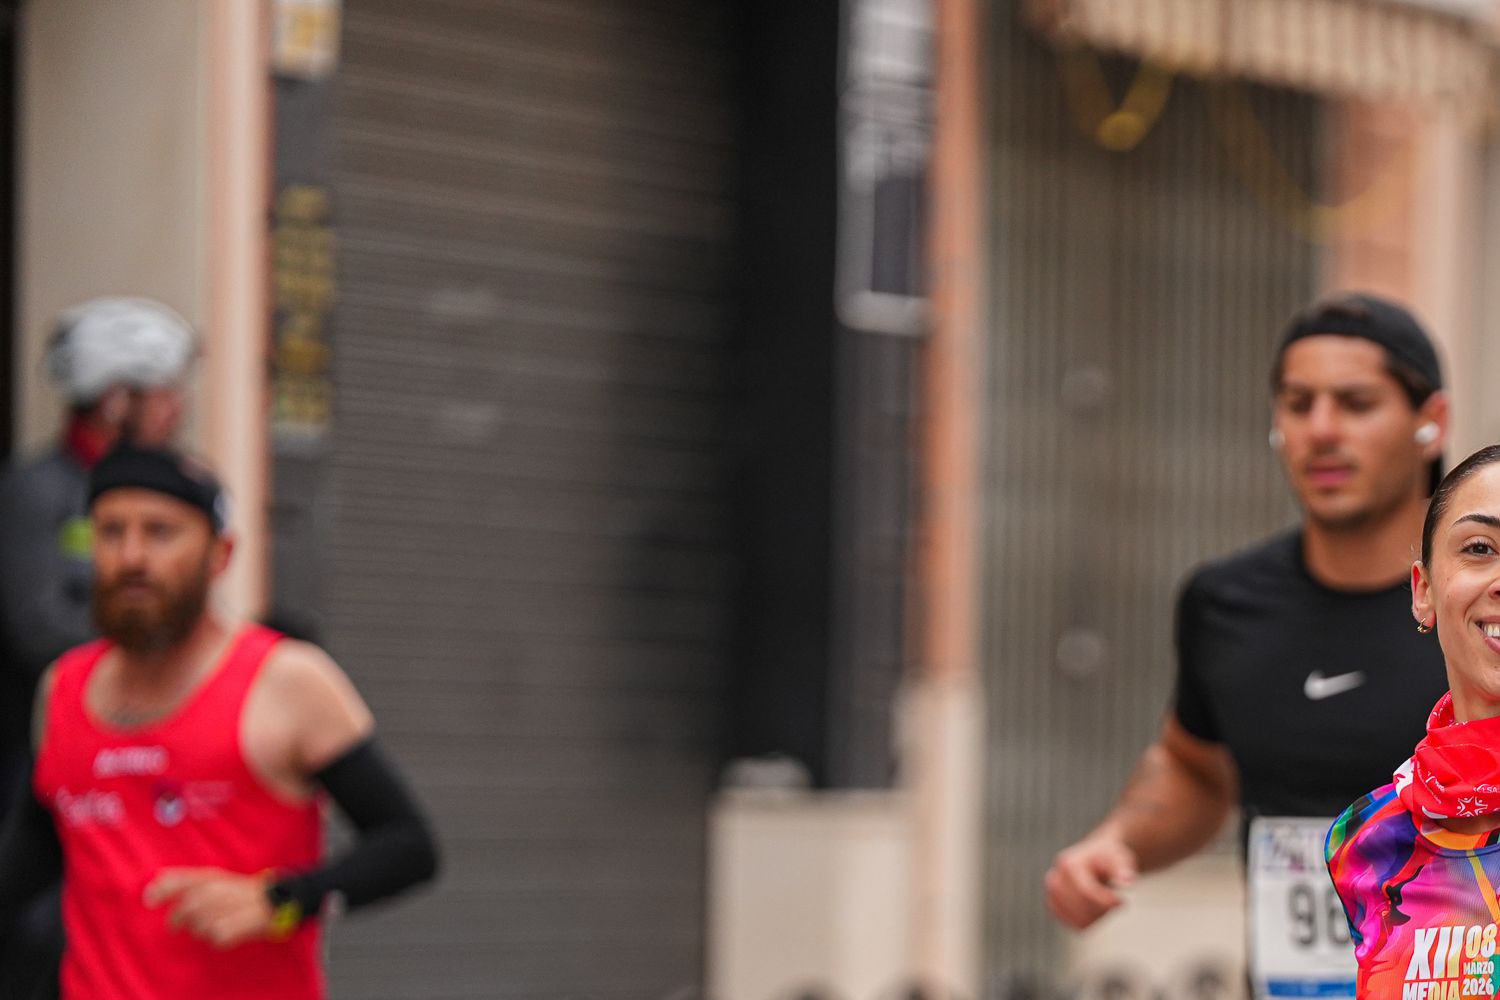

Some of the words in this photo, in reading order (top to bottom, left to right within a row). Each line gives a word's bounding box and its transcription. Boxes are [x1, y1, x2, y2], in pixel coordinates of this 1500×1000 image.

[1404, 925, 1466, 981] XII
[1465, 923, 1498, 959] 08
[1463, 960, 1495, 976] MARZO
[1462, 978, 1494, 996] 2026
